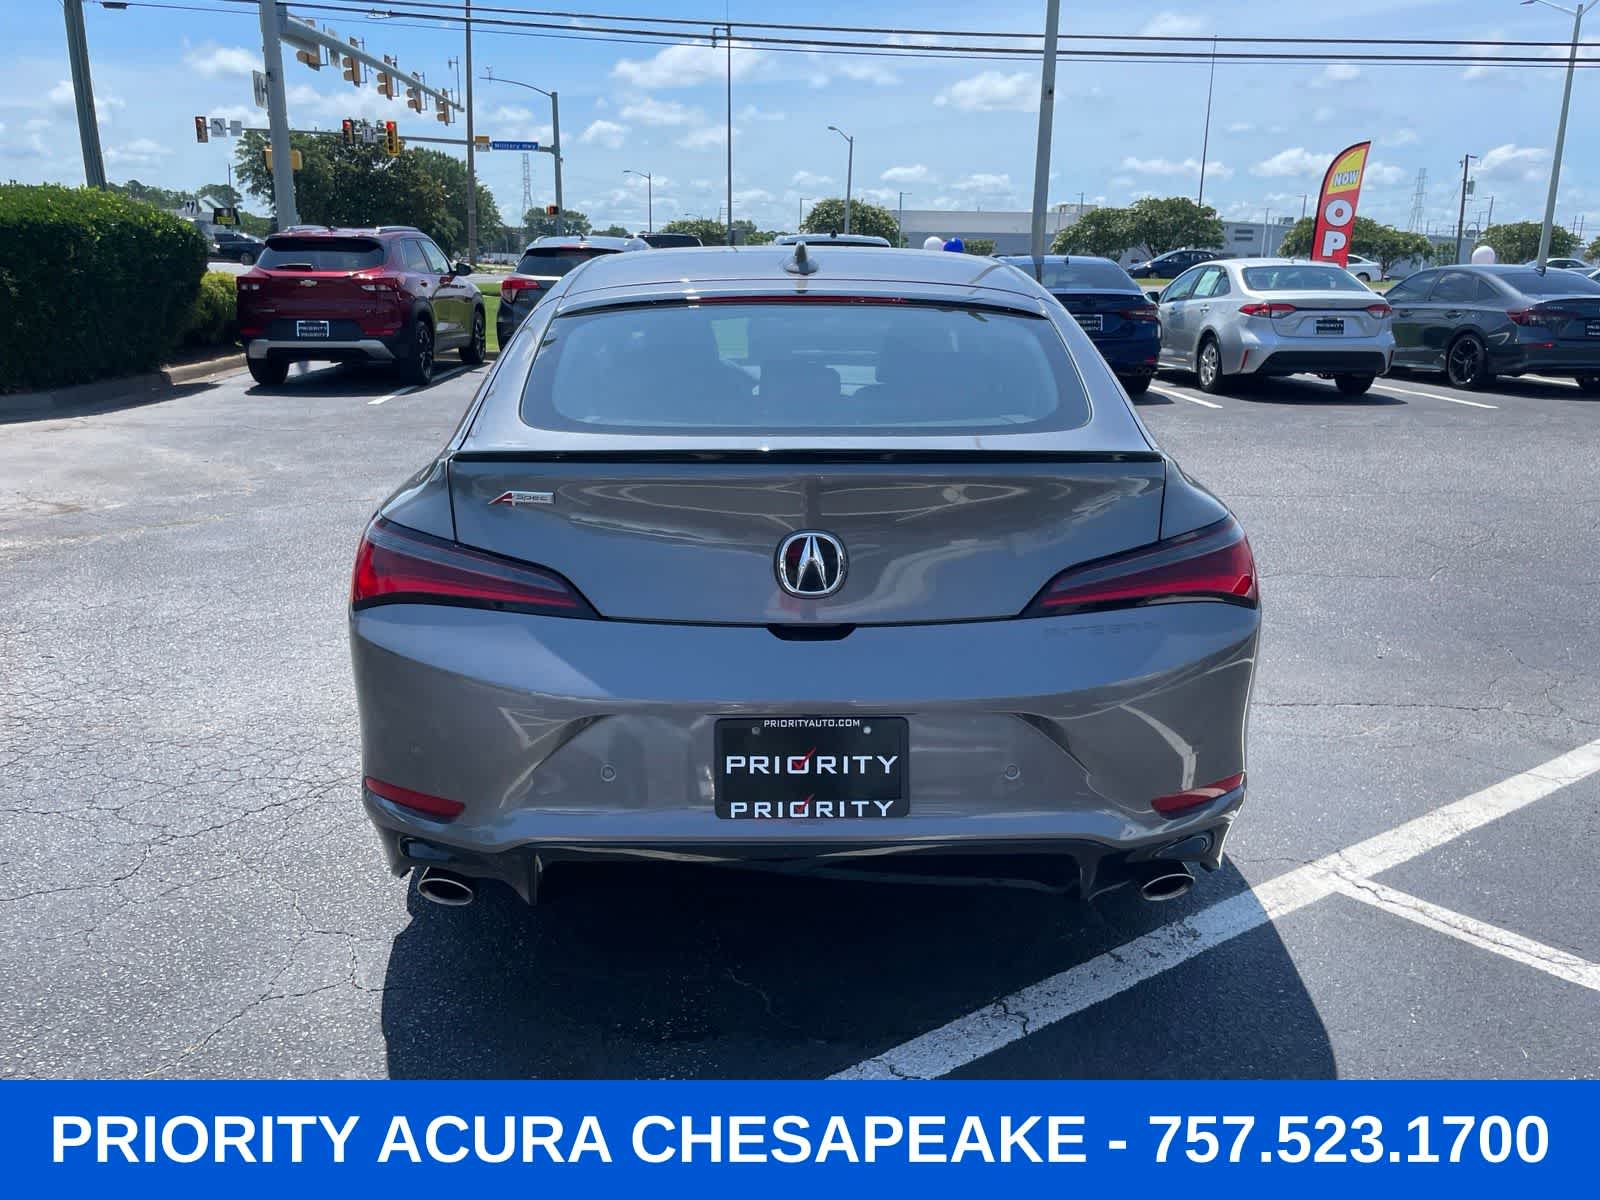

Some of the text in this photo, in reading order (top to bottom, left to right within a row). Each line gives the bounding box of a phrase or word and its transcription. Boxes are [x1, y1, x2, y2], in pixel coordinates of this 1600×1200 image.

[1334, 170, 1359, 186] NOW
[764, 719, 860, 728] PRIORITYAUTO.COM
[726, 755, 898, 774] PRIORITY
[730, 800, 894, 818] PRIORITY
